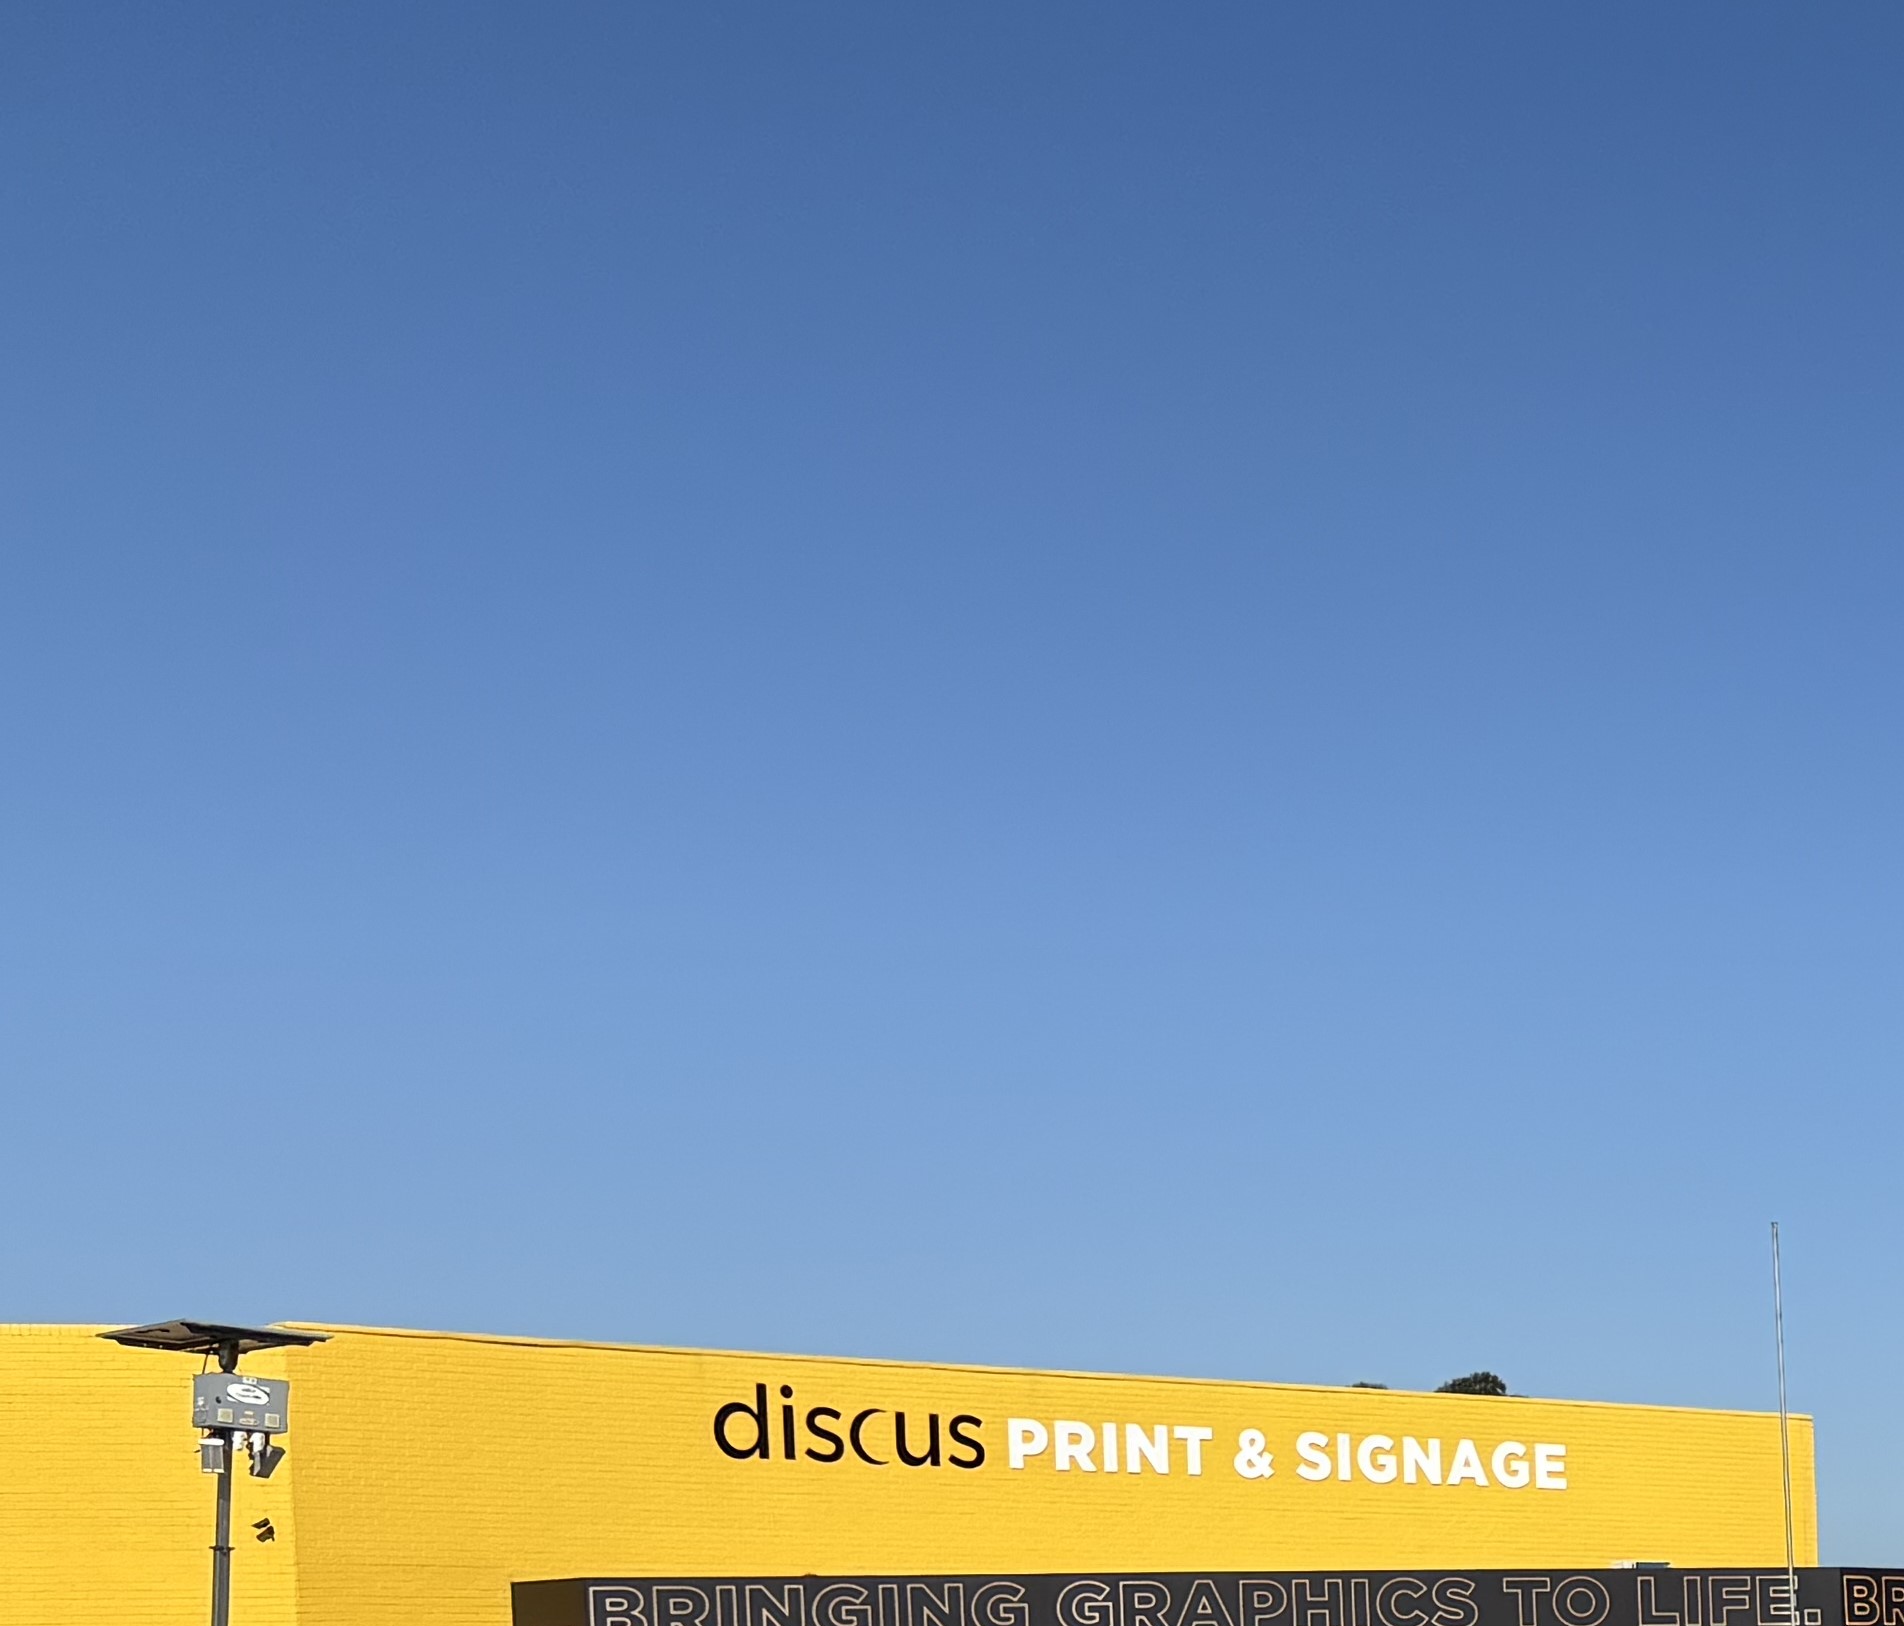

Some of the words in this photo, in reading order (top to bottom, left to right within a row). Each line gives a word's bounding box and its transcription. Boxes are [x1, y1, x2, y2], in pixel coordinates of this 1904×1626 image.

[712, 1382, 985, 1469] discus
[1006, 1416, 1213, 1476] PRINT
[1233, 1428, 1275, 1480] &
[1295, 1429, 1568, 1491] SIGNAGE
